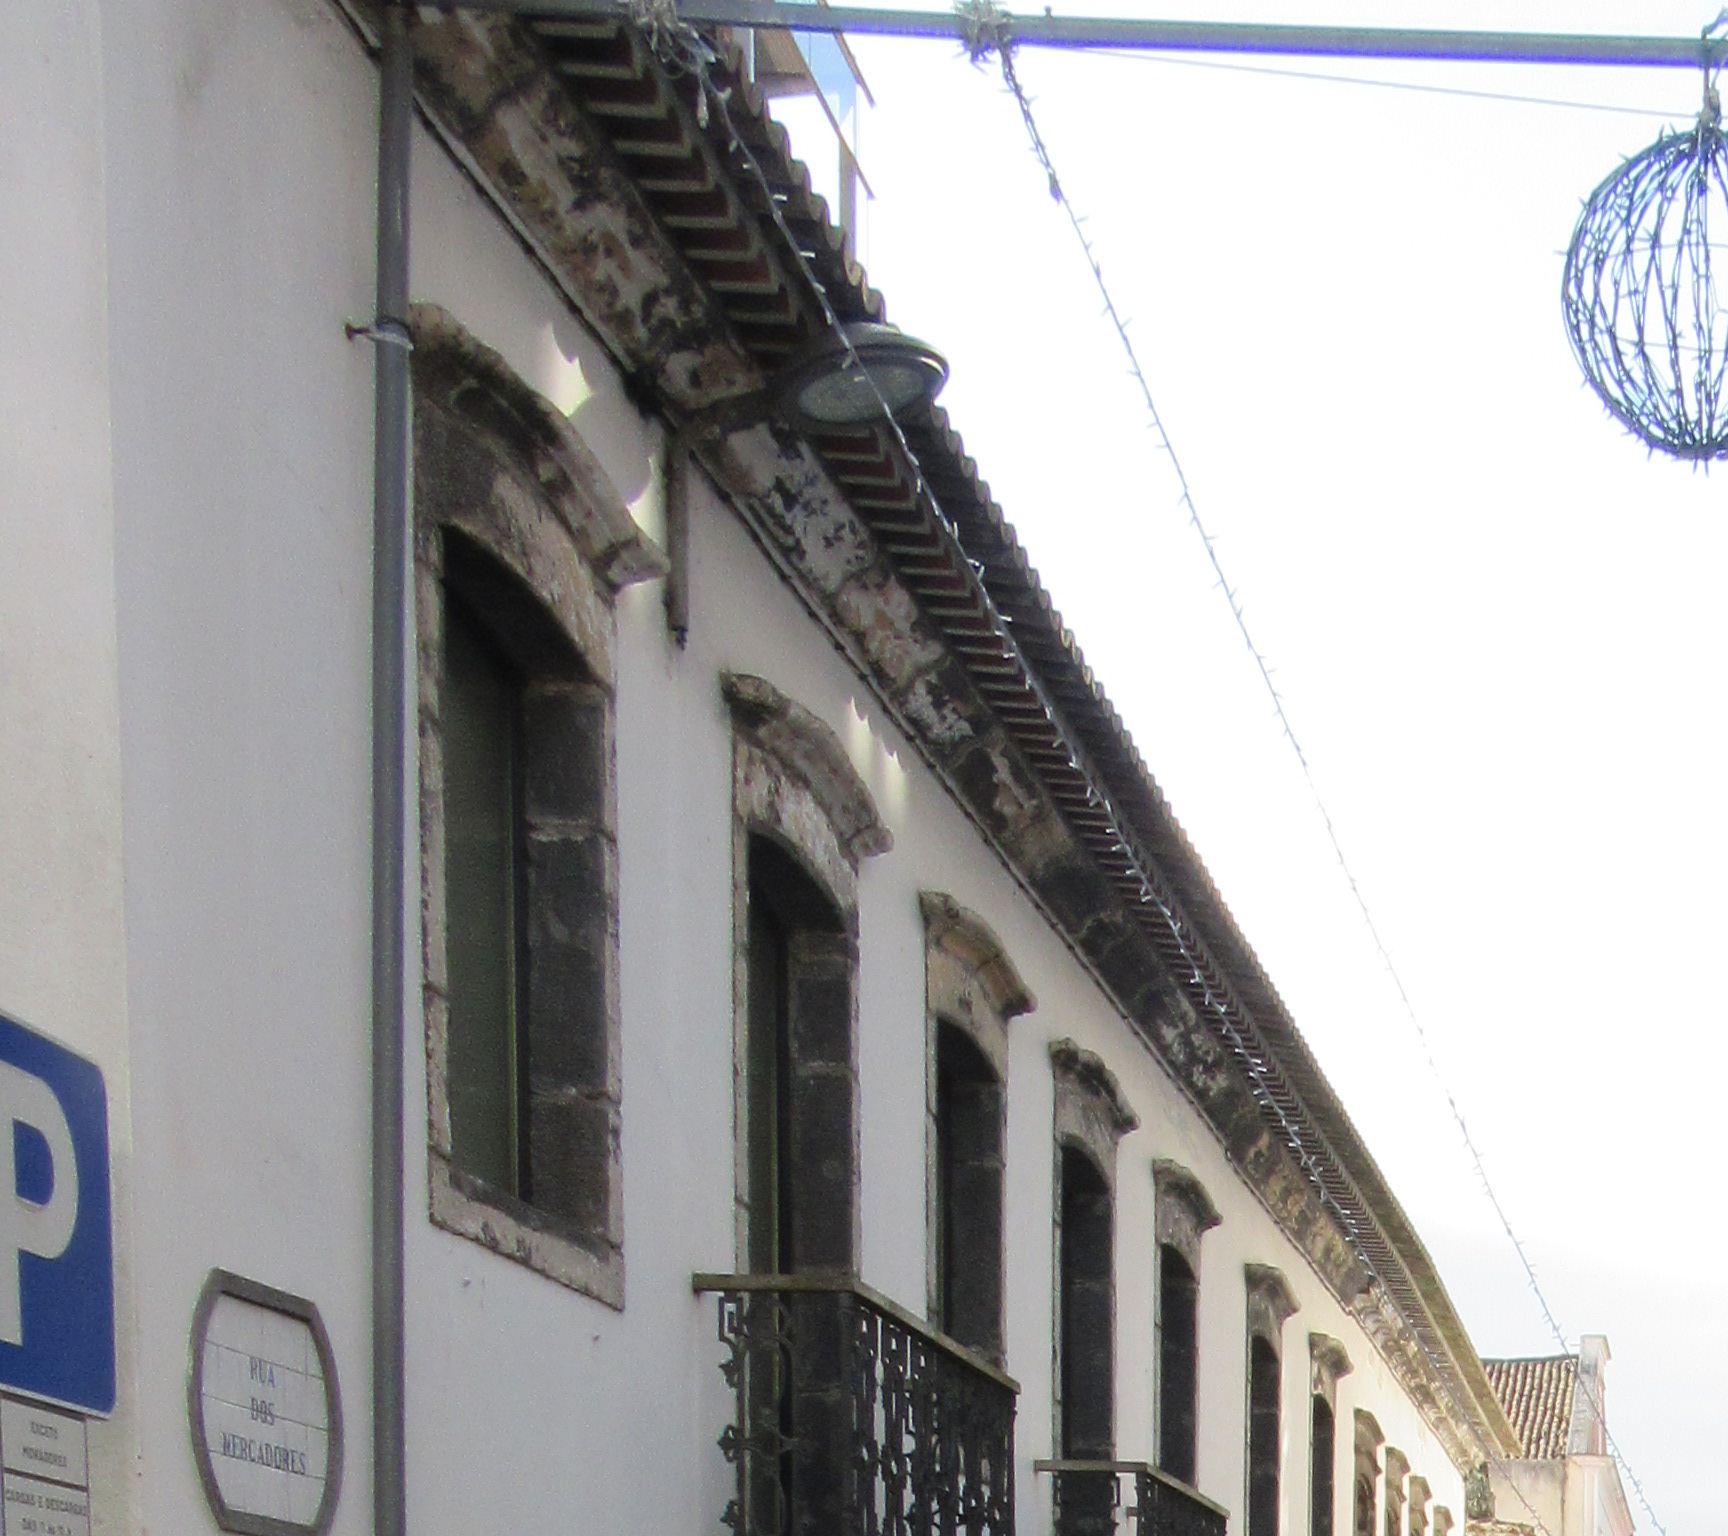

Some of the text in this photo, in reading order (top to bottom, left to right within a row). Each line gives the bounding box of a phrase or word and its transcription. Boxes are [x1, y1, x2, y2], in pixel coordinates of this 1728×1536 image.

[0, 1058, 78, 1347] P
[250, 1356, 276, 1388] RUA
[251, 1398, 275, 1426] DOS
[222, 1432, 306, 1475] MERCADORES
